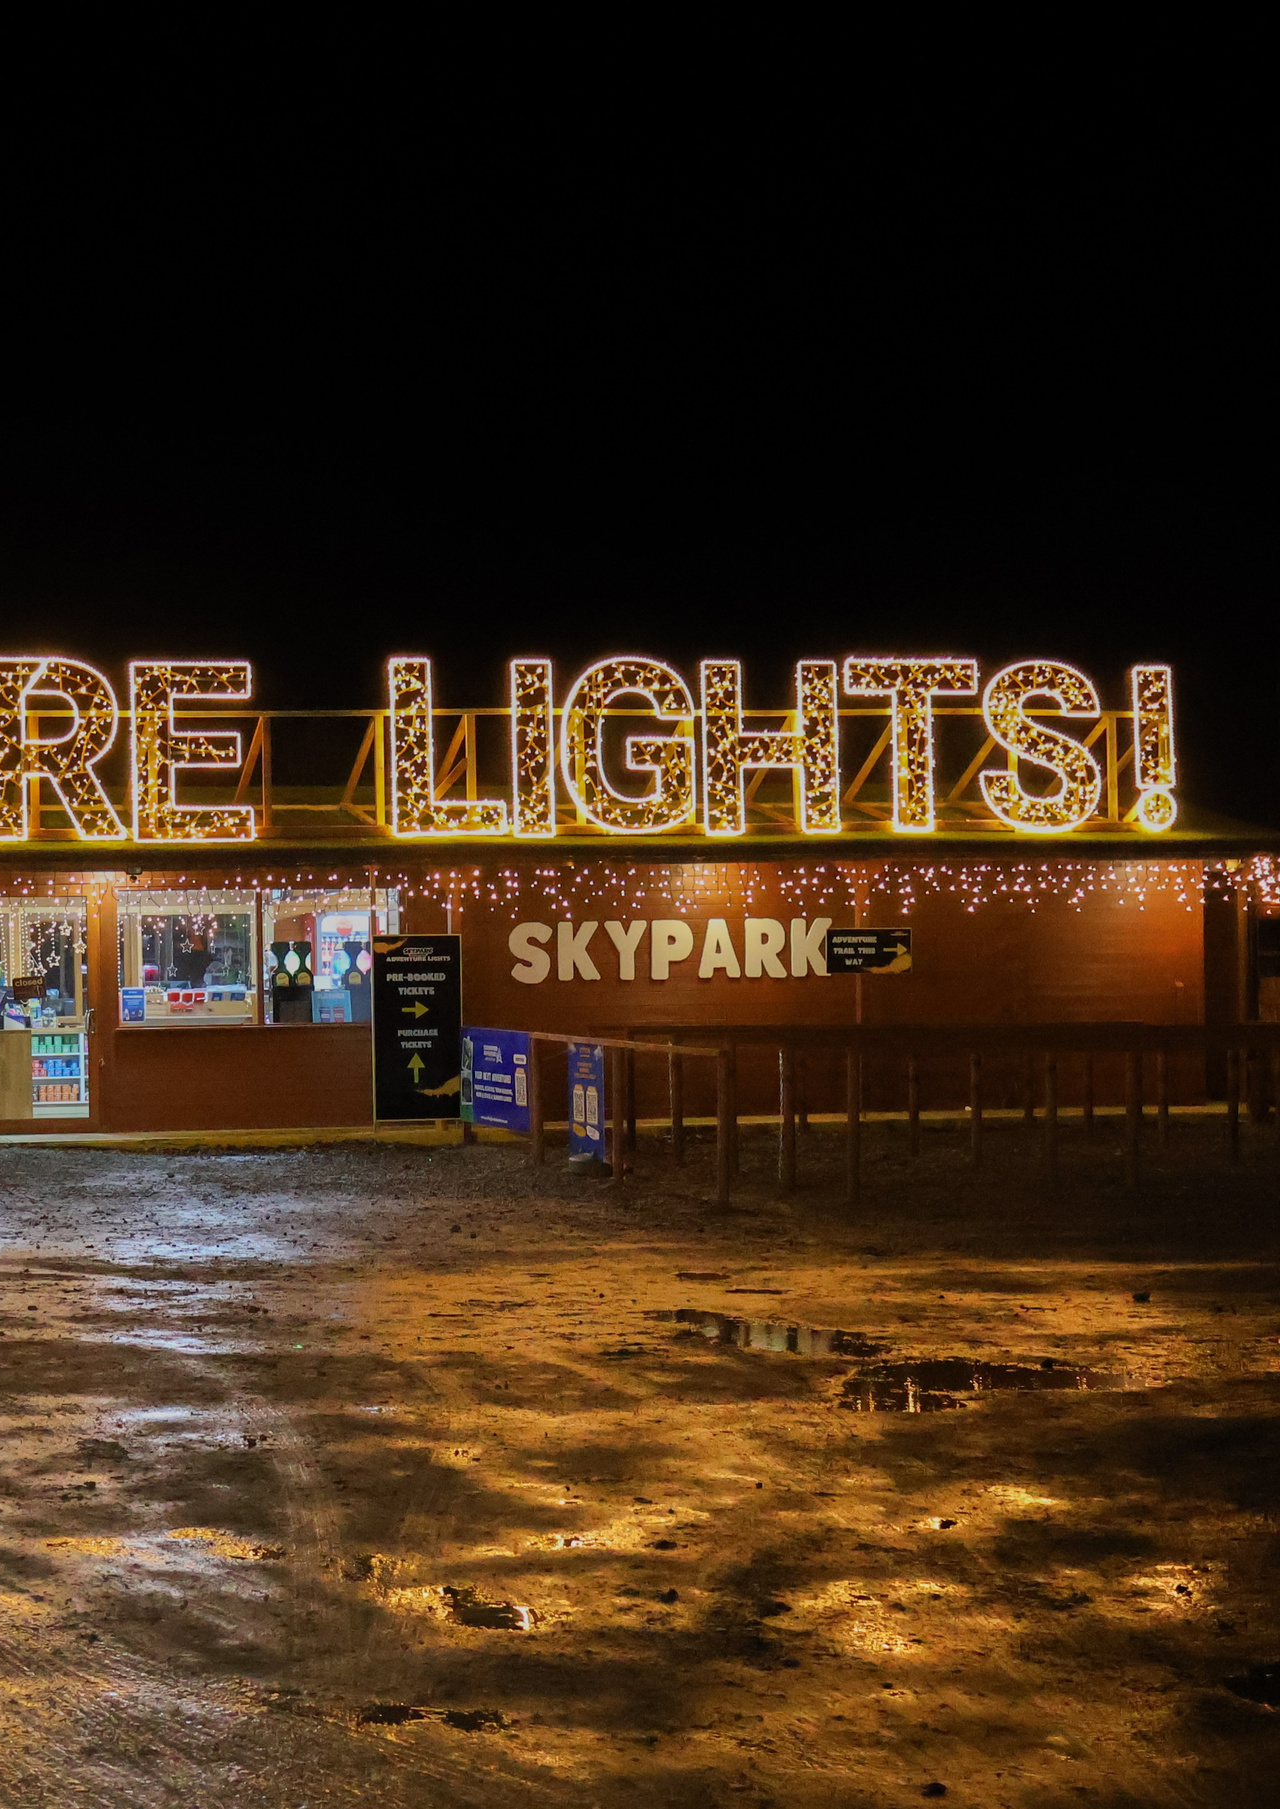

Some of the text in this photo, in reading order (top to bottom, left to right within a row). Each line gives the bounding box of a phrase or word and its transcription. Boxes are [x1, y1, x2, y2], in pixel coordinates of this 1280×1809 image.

[387, 655, 1179, 838] LIGHTS!
[508, 917, 832, 984] SKYPARK
[858, 947, 876, 955] THIS
[386, 973, 446, 982] PRE-BOOKED
[15, 978, 42, 987] closed
[398, 987, 435, 995] TICKETS
[398, 1029, 438, 1037] PURCHASE
